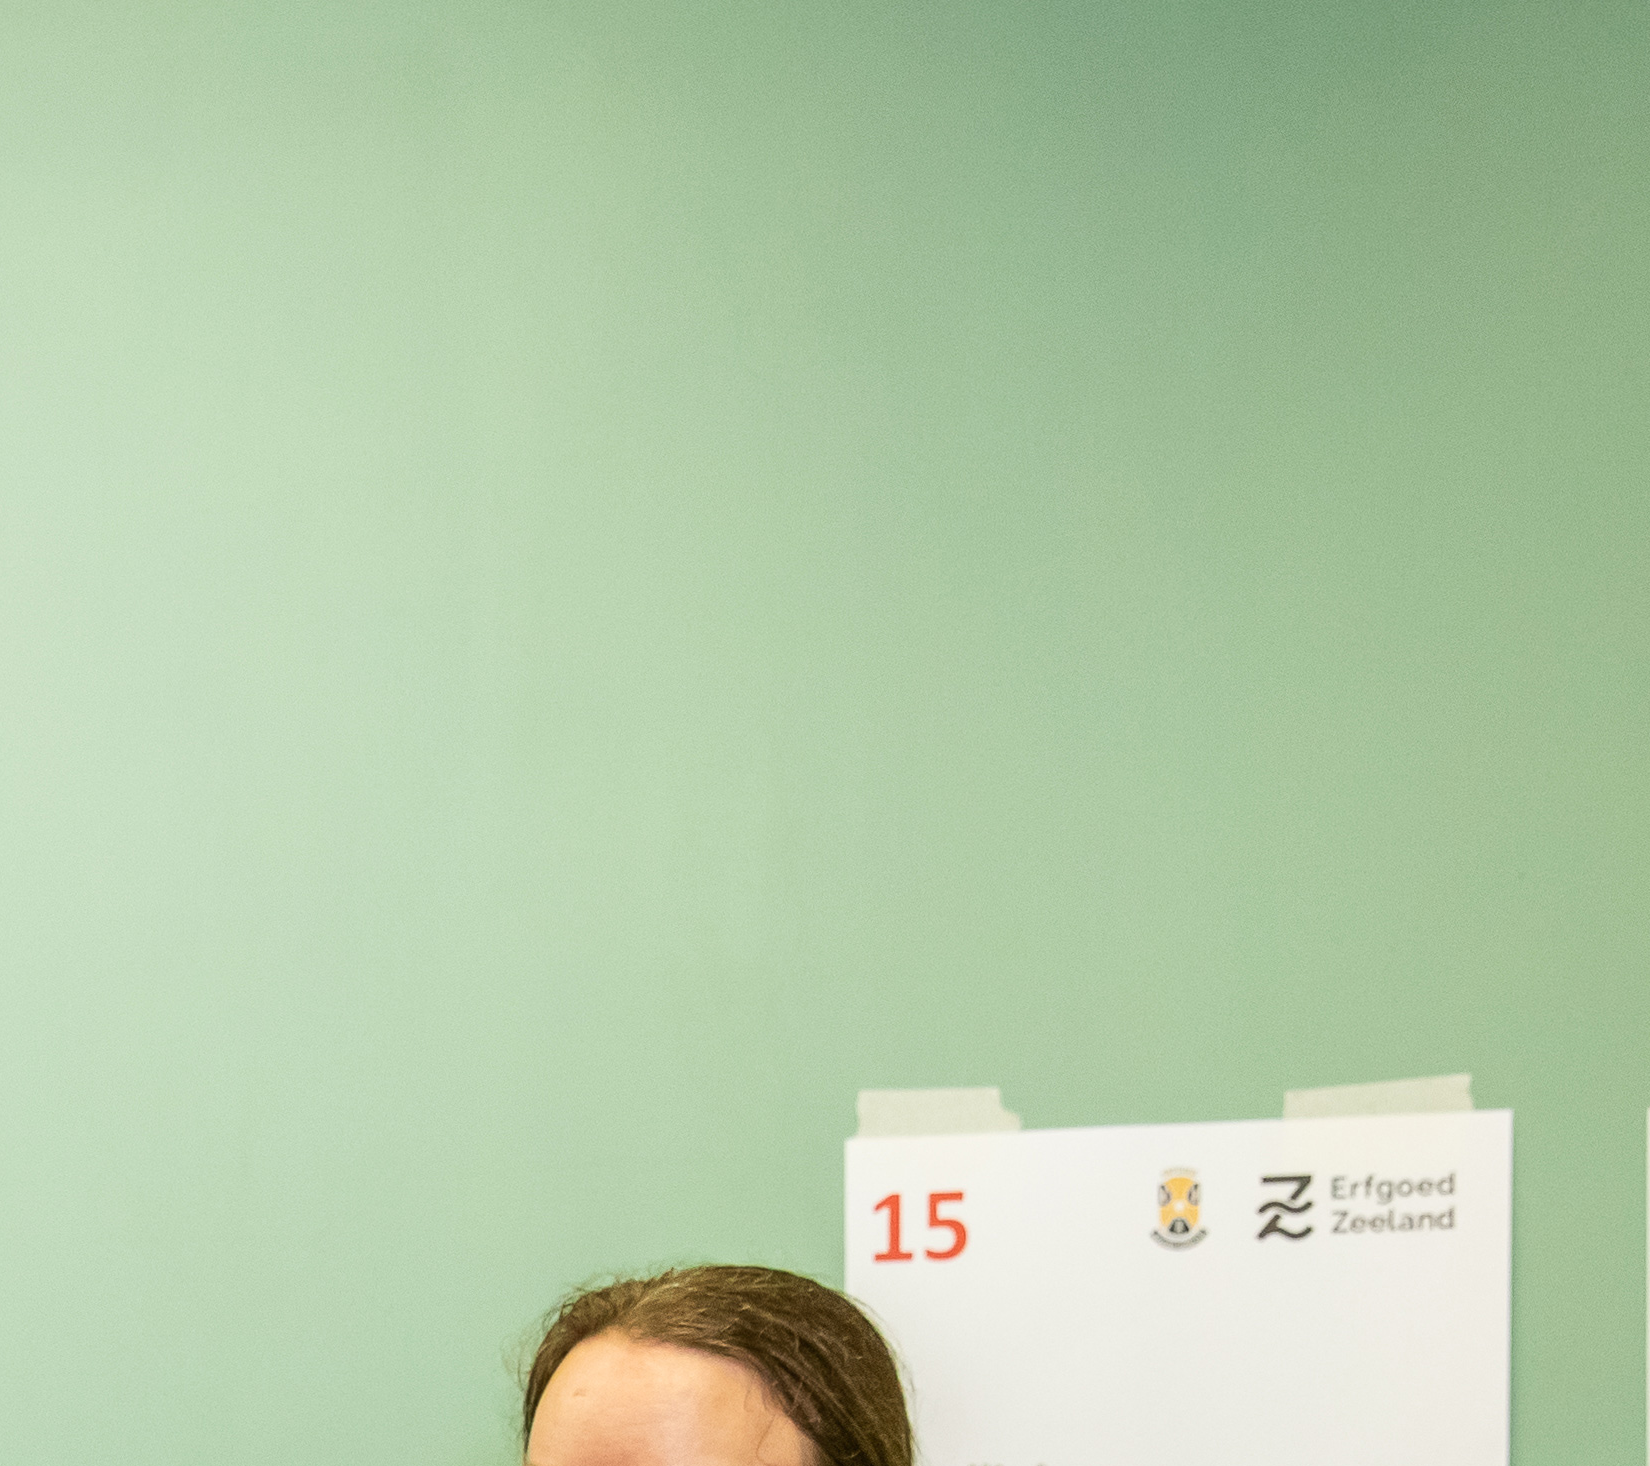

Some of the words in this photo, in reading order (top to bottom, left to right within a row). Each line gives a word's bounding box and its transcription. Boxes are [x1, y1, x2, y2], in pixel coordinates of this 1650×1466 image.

[1330, 1173, 1456, 1205] Erfgoed
[872, 1191, 969, 1262] 15
[1330, 1208, 1457, 1235] Zeeland
